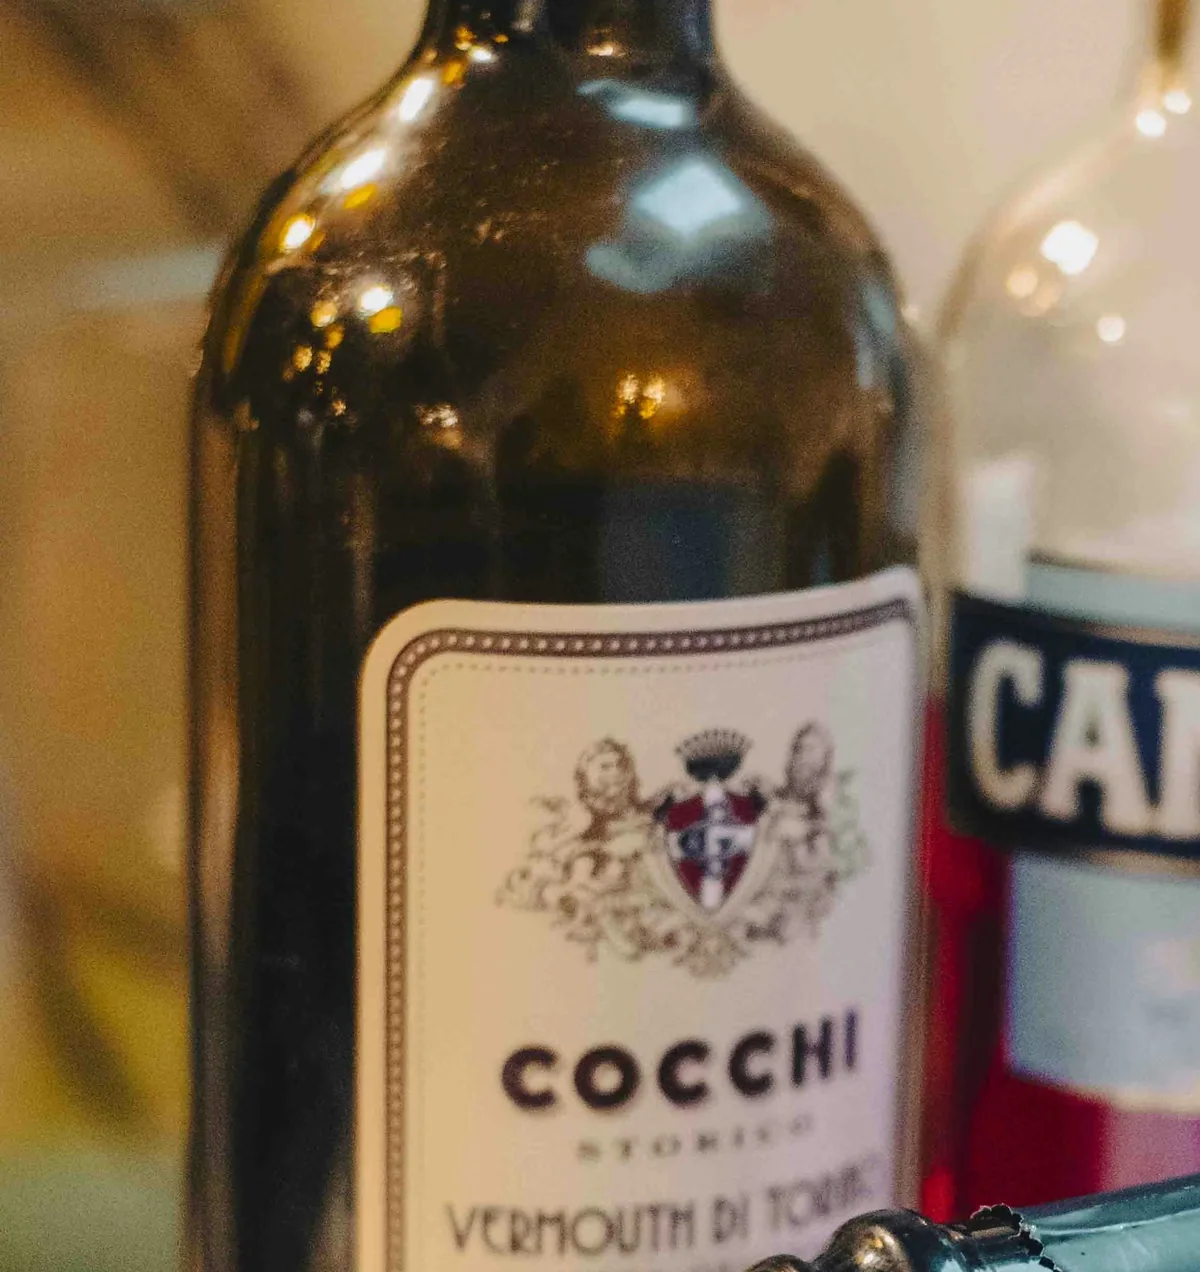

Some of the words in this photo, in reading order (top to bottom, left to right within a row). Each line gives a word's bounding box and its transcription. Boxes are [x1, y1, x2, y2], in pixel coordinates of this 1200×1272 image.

[501, 1005, 858, 1112] COCCHI
[446, 1203, 694, 1258] VERMOUTH
[713, 1192, 750, 1246] DI
